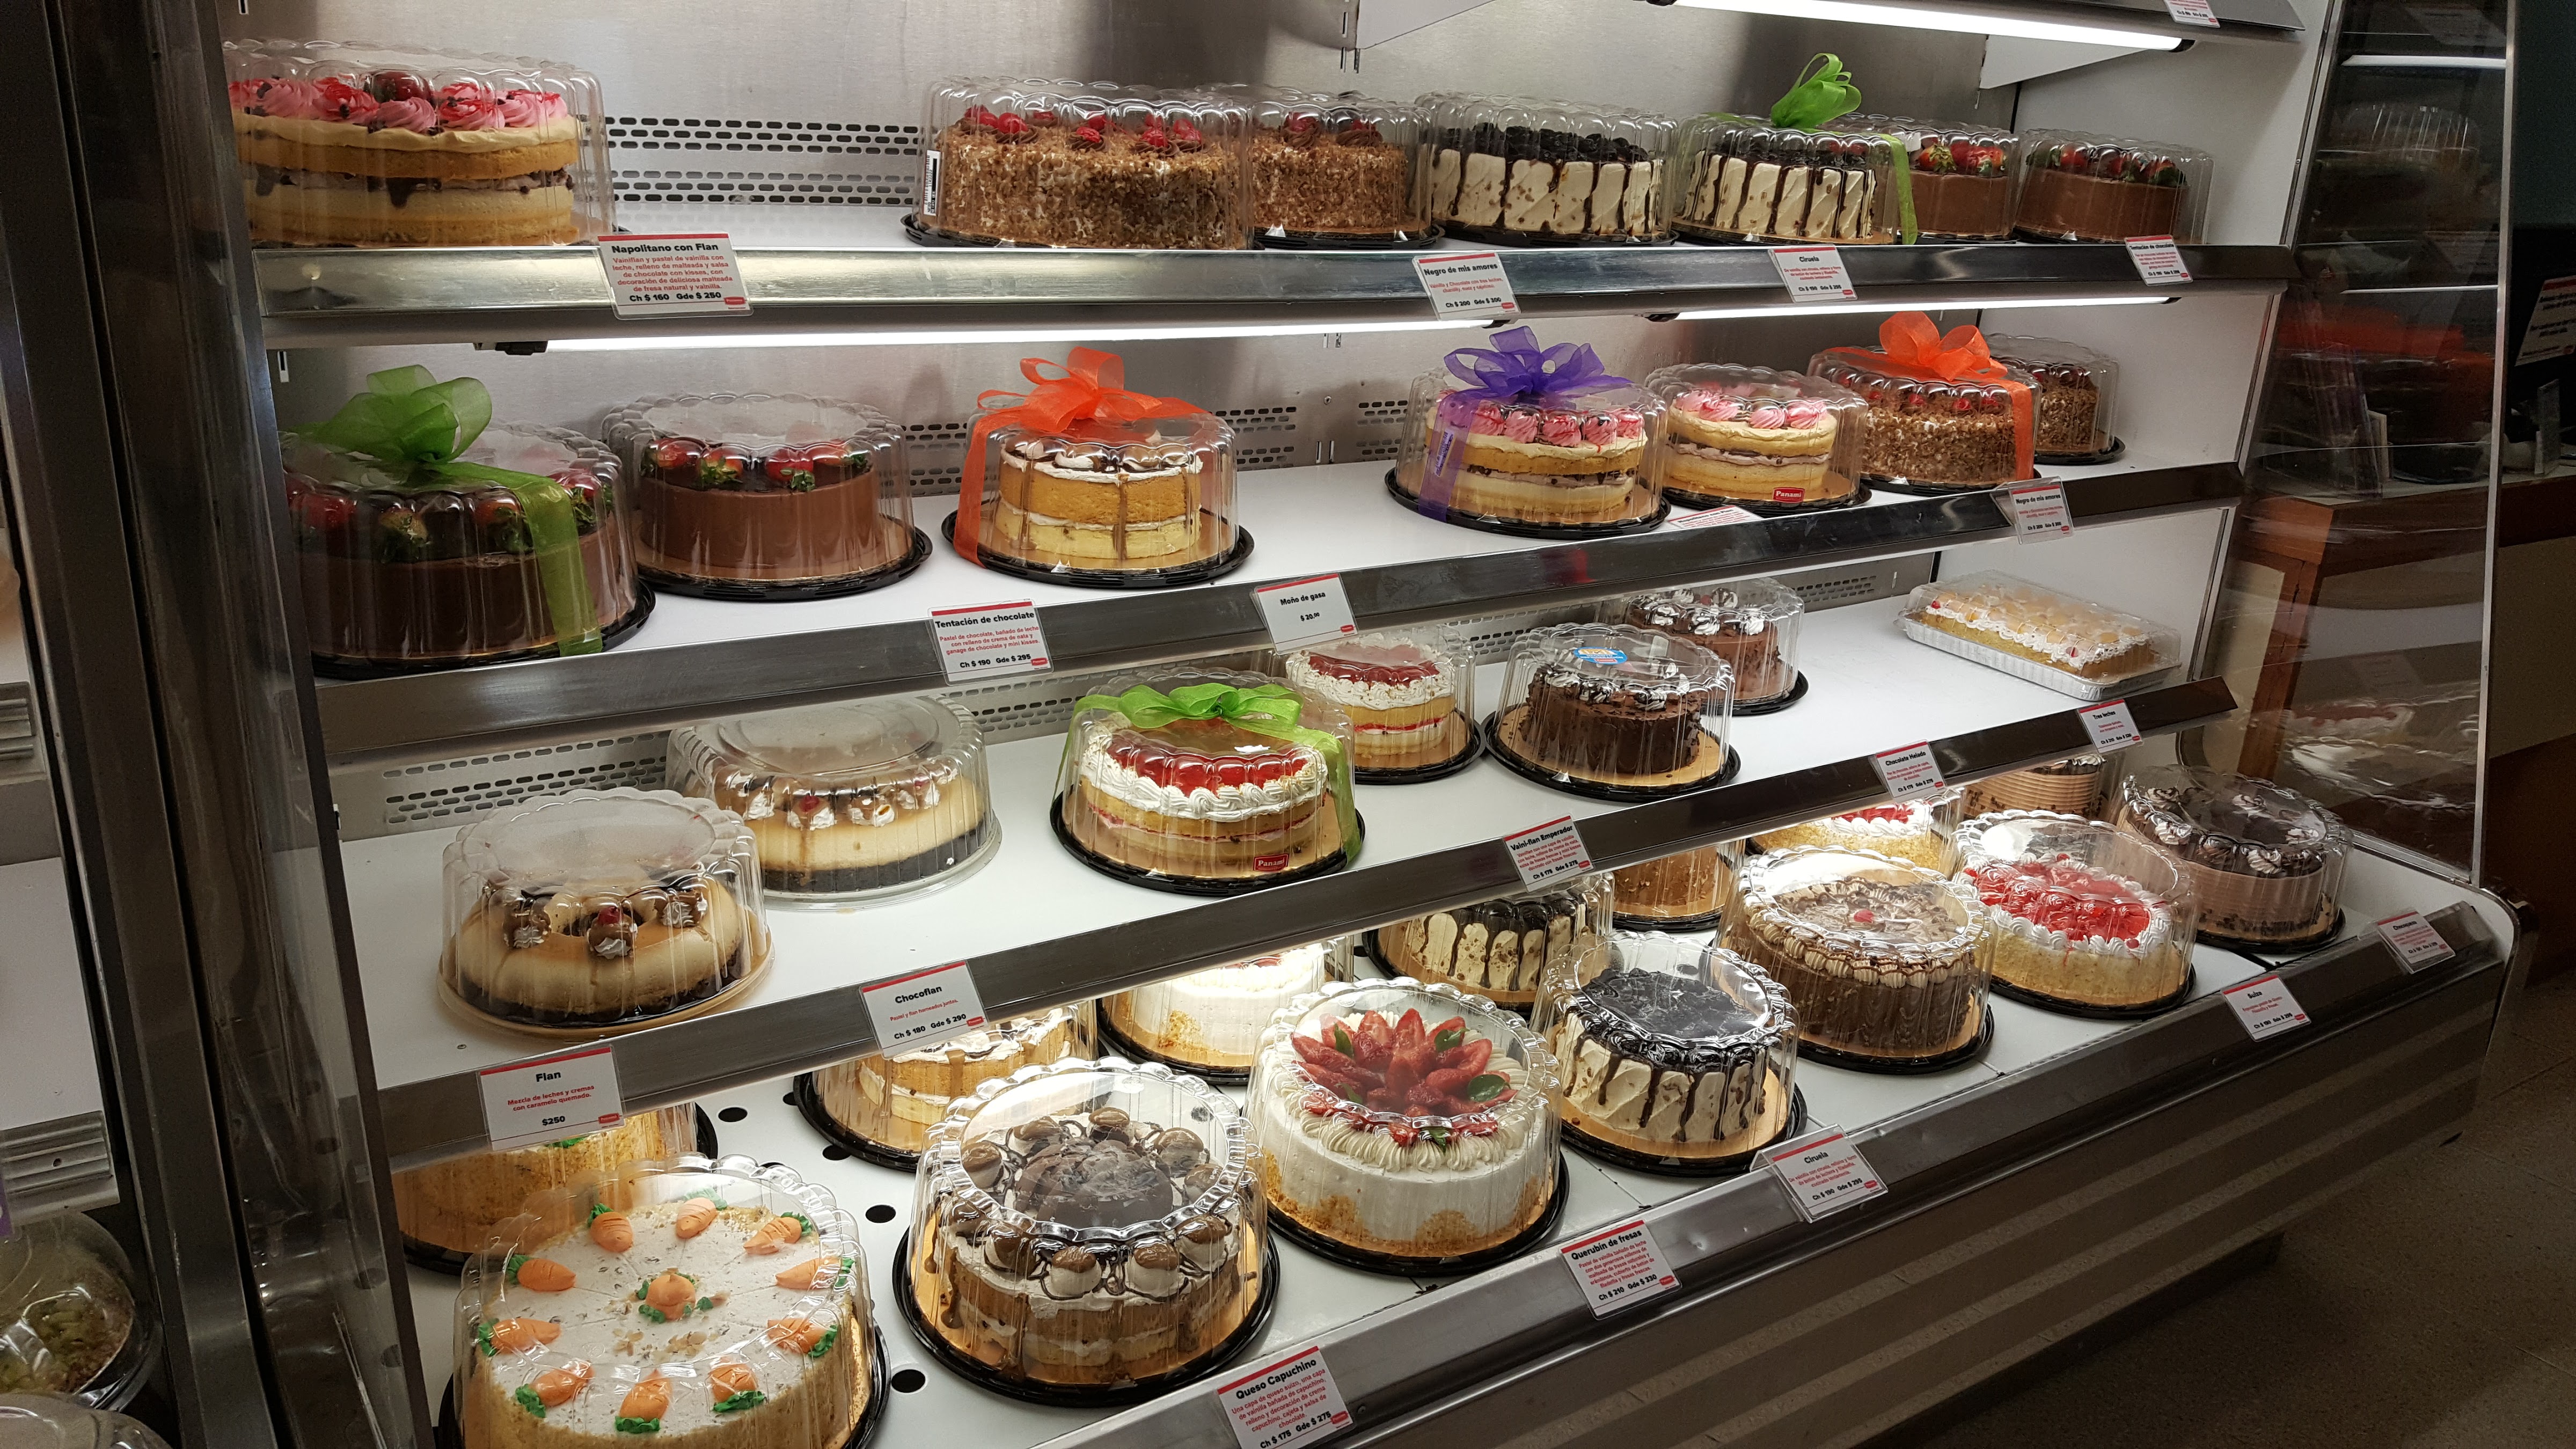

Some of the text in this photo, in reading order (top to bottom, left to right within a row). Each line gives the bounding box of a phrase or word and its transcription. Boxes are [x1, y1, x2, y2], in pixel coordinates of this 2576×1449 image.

[611, 244, 671, 254] Napolitano
[1279, 597, 1299, 605] Moño
[1309, 592, 1326, 601] gasa
[934, 617, 978, 628] Tentación
[993, 612, 1034, 621] chocolate
[1510, 825, 1572, 850] Vaini-flan Emperador
[895, 986, 942, 1003] Chocoflan
[890, 1013, 904, 1021] Pastel
[952, 1014, 966, 1022] 290
[536, 1072, 561, 1082] Flan
[507, 1097, 531, 1105] Mezcla
[570, 1085, 594, 1093] cremas
[526, 1099, 557, 1108] caramelo
[541, 1115, 565, 1126] $250
[1804, 1152, 1828, 1163] Ciruela
[1571, 1242, 1607, 1260] Querubín
[1618, 1230, 1642, 1243] fresas
[1612, 1286, 1624, 1295] 210
[1644, 1274, 1657, 1282] 330
[1236, 1359, 1316, 1399] Queso Capuchino
[1244, 1399, 1258, 1408] capa
[1266, 1388, 1283, 1399] queso
[1312, 1369, 1325, 1377] capa
[1245, 1414, 1265, 1426] relleno
[1270, 1397, 1300, 1414] decoración
[1308, 1386, 1326, 1396] crema
[1246, 1404, 1267, 1416] vainilla
[1267, 1394, 1288, 1407] bañada
[1283, 1407, 1299, 1417] cajeta
[1304, 1398, 1319, 1408] salsa
[1260, 1440, 1271, 1448] Ch
[1271, 1436, 1277, 1444] $
[1278, 1429, 1291, 1440] 175
[1295, 1422, 1310, 1432] Gde
[1316, 1410, 1333, 1422] 275
